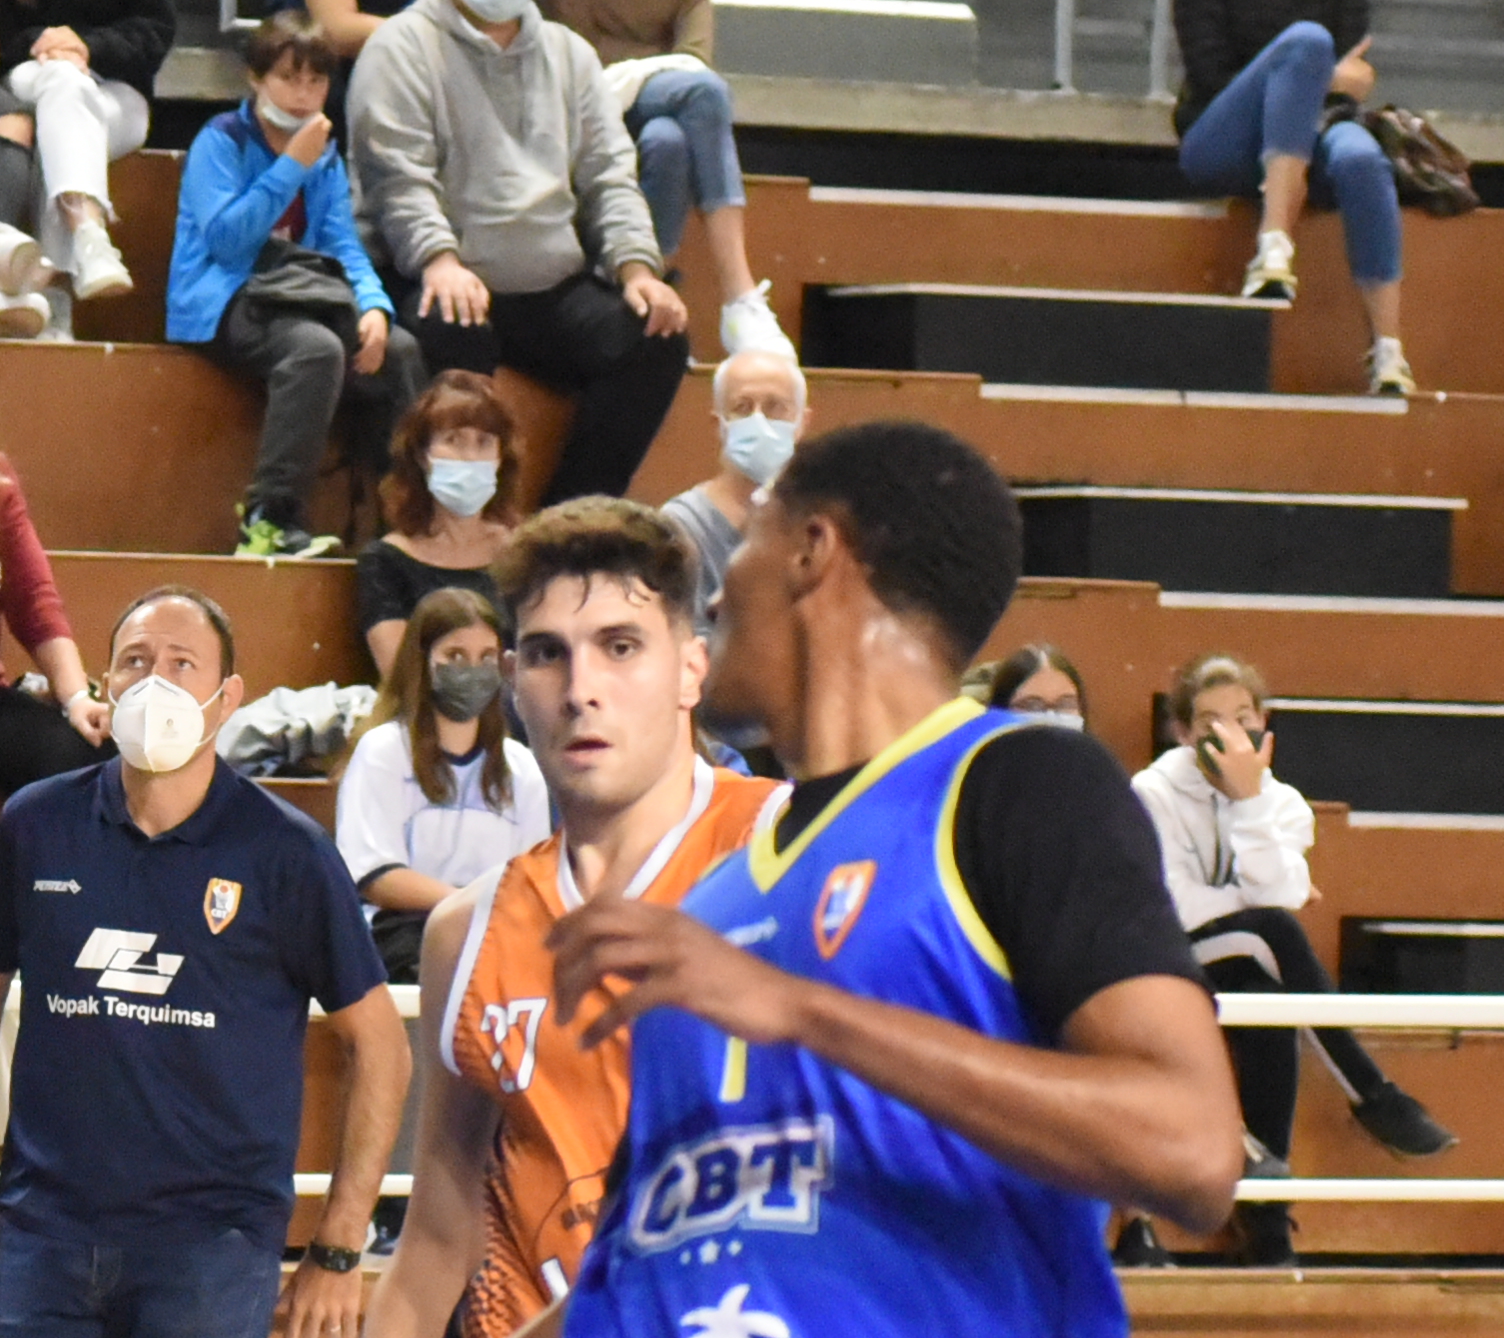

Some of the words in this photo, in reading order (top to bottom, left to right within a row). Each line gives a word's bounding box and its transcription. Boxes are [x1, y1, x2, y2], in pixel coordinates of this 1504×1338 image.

[47, 993, 100, 1019] Vopak
[103, 996, 216, 1029] Terquimsa
[635, 1129, 826, 1241] CBT
